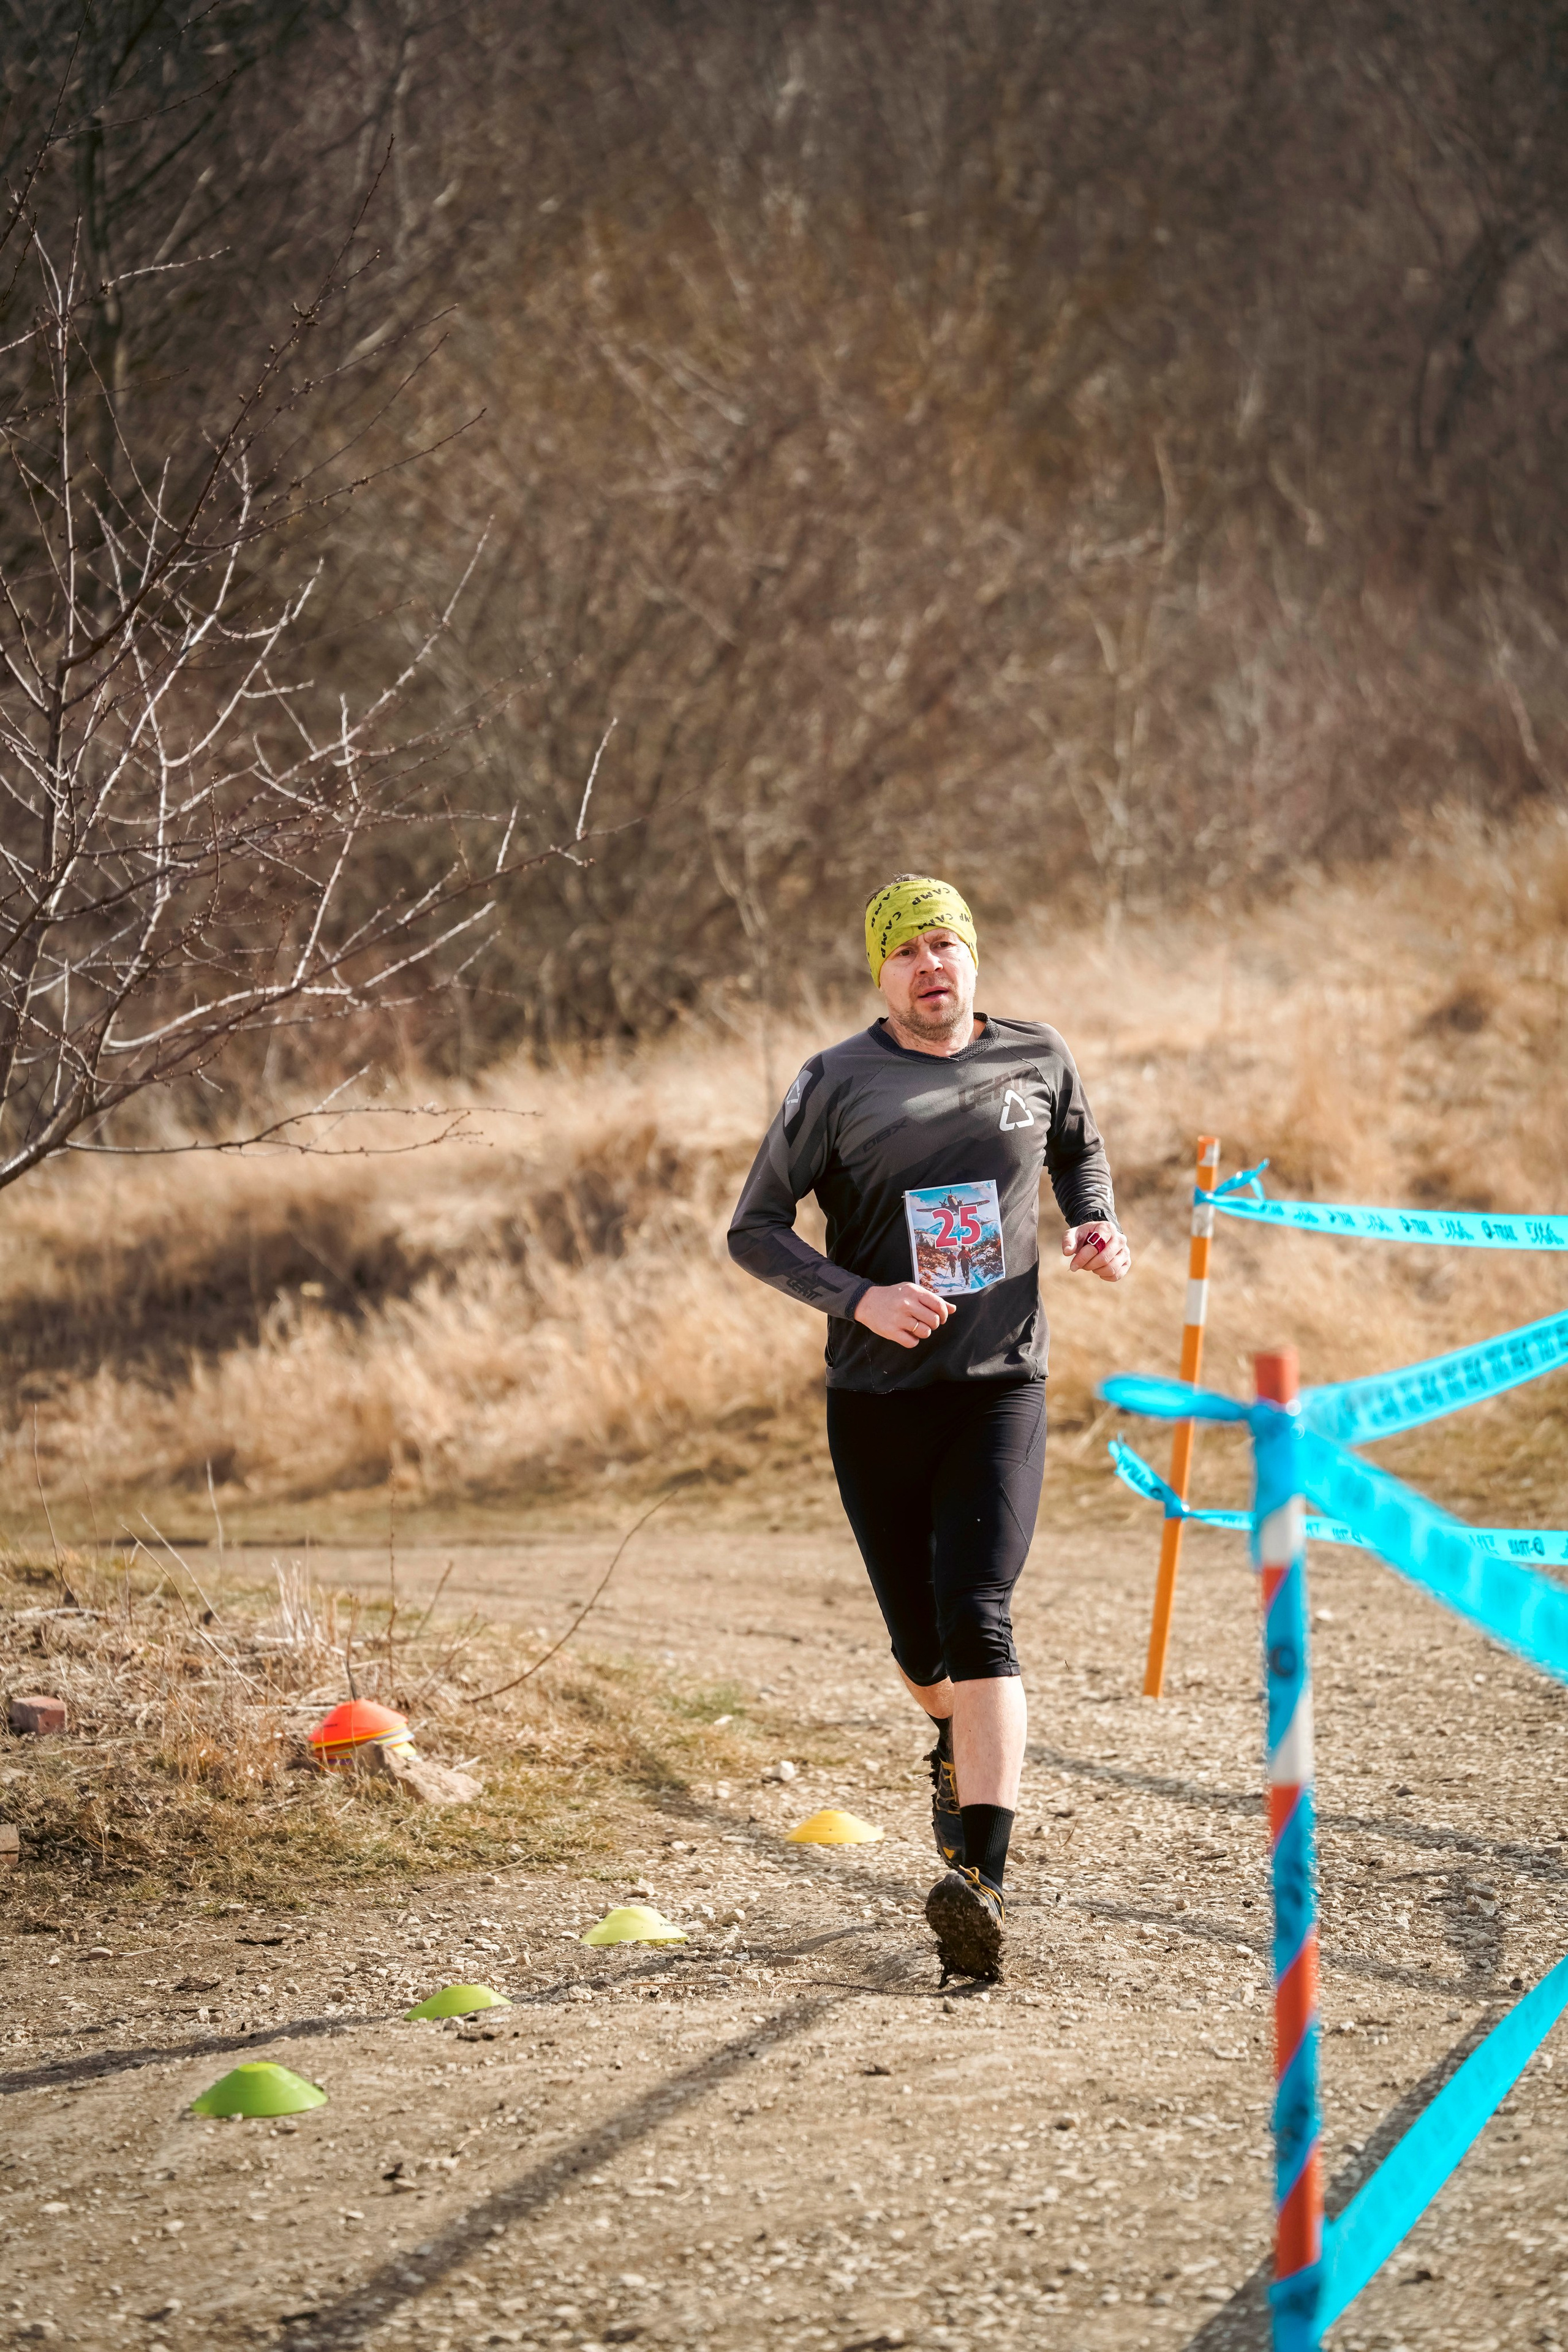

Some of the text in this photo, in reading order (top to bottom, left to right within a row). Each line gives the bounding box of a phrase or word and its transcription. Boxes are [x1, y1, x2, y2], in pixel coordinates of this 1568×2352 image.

[872, 886, 901, 927] CAMP
[912, 888, 951, 905] CAMP
[880, 911, 902, 958] CAMP
[932, 1205, 981, 1248] 25
